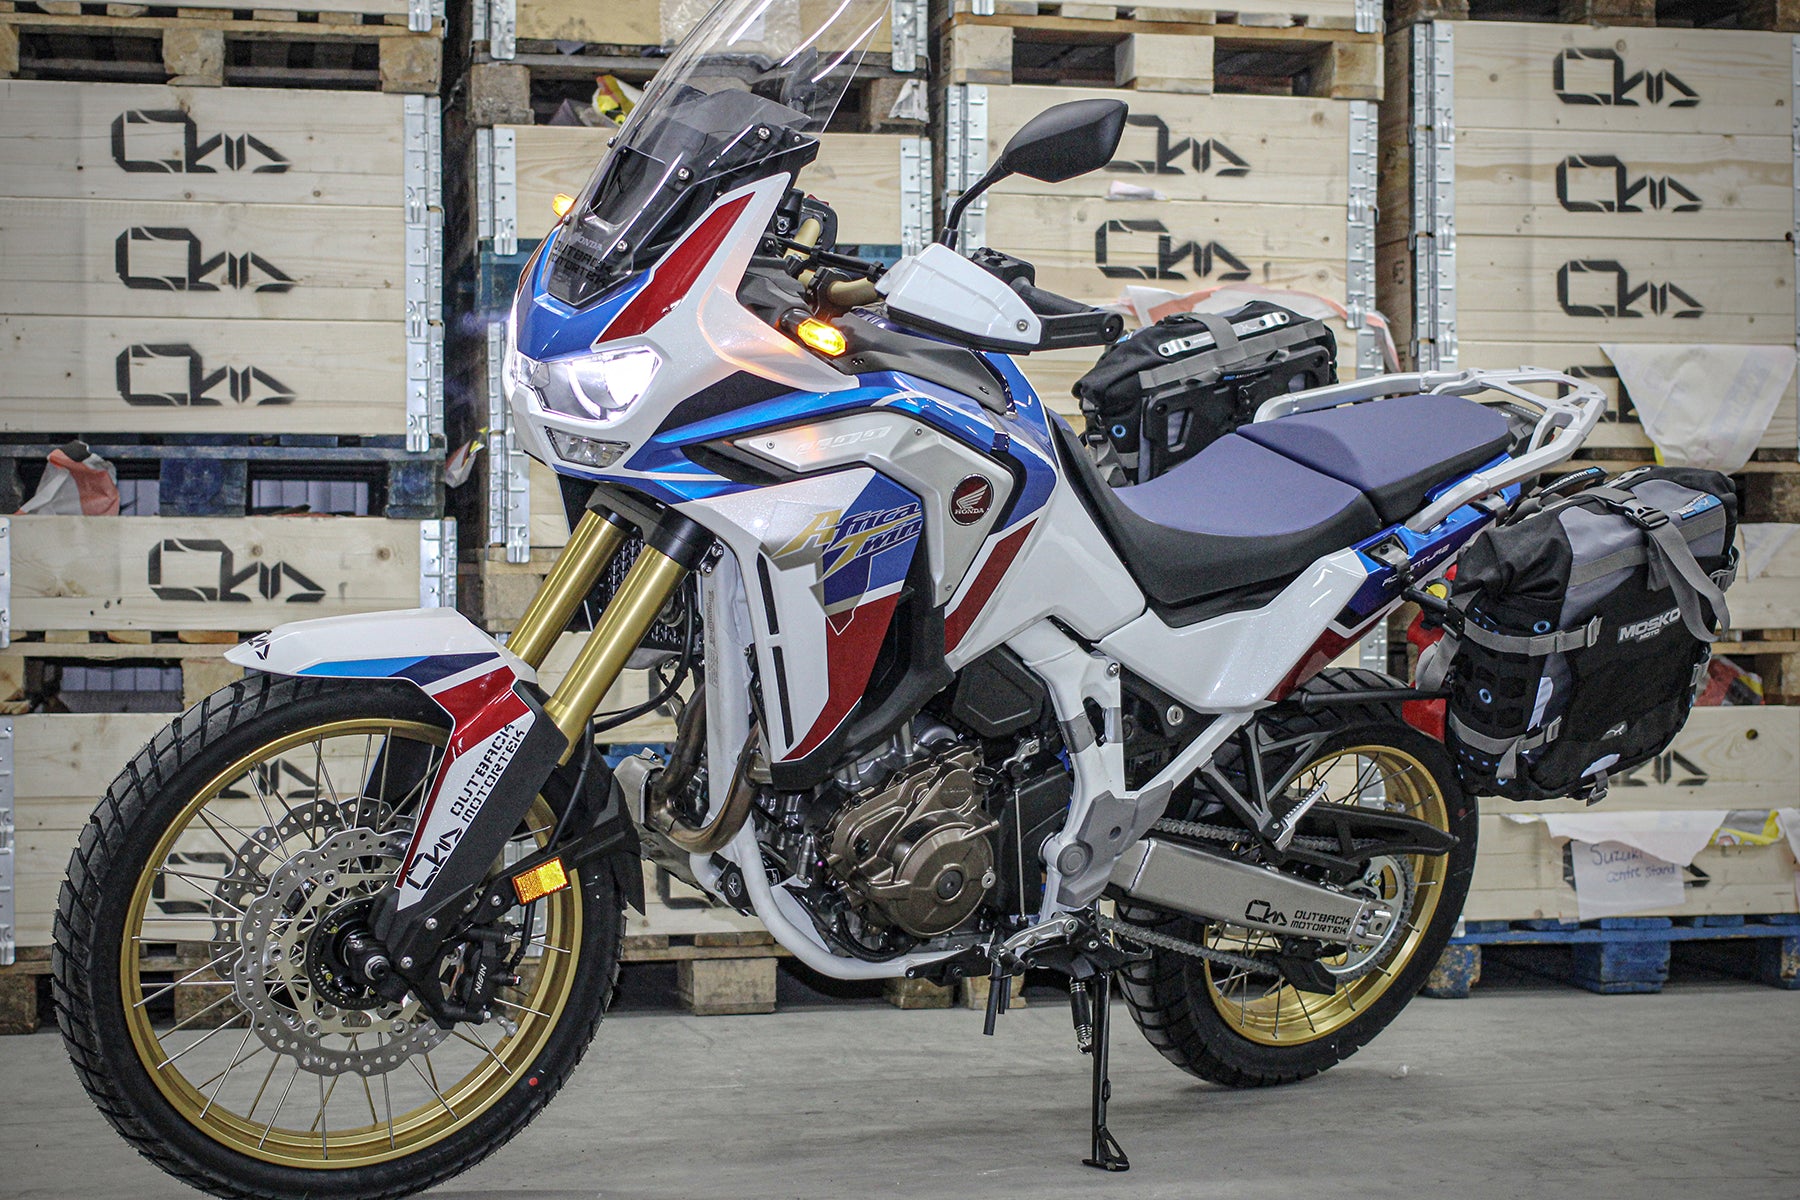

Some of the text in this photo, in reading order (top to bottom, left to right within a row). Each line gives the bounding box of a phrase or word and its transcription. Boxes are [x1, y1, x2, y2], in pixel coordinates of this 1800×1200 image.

[954, 507, 985, 515] HONDA
[771, 502, 922, 560] Africa
[816, 511, 923, 583] Twin
[1619, 608, 1681, 641] MOSKO
[1639, 628, 1660, 641] MOTO
[450, 724, 514, 817] OUTBACK
[462, 730, 525, 823] MOTORTEK
[1589, 843, 1643, 866] Suzuki
[1645, 864, 1676, 878] stand
[1290, 920, 1348, 935] MOTORTEK
[1294, 909, 1351, 925] OUTBACK
